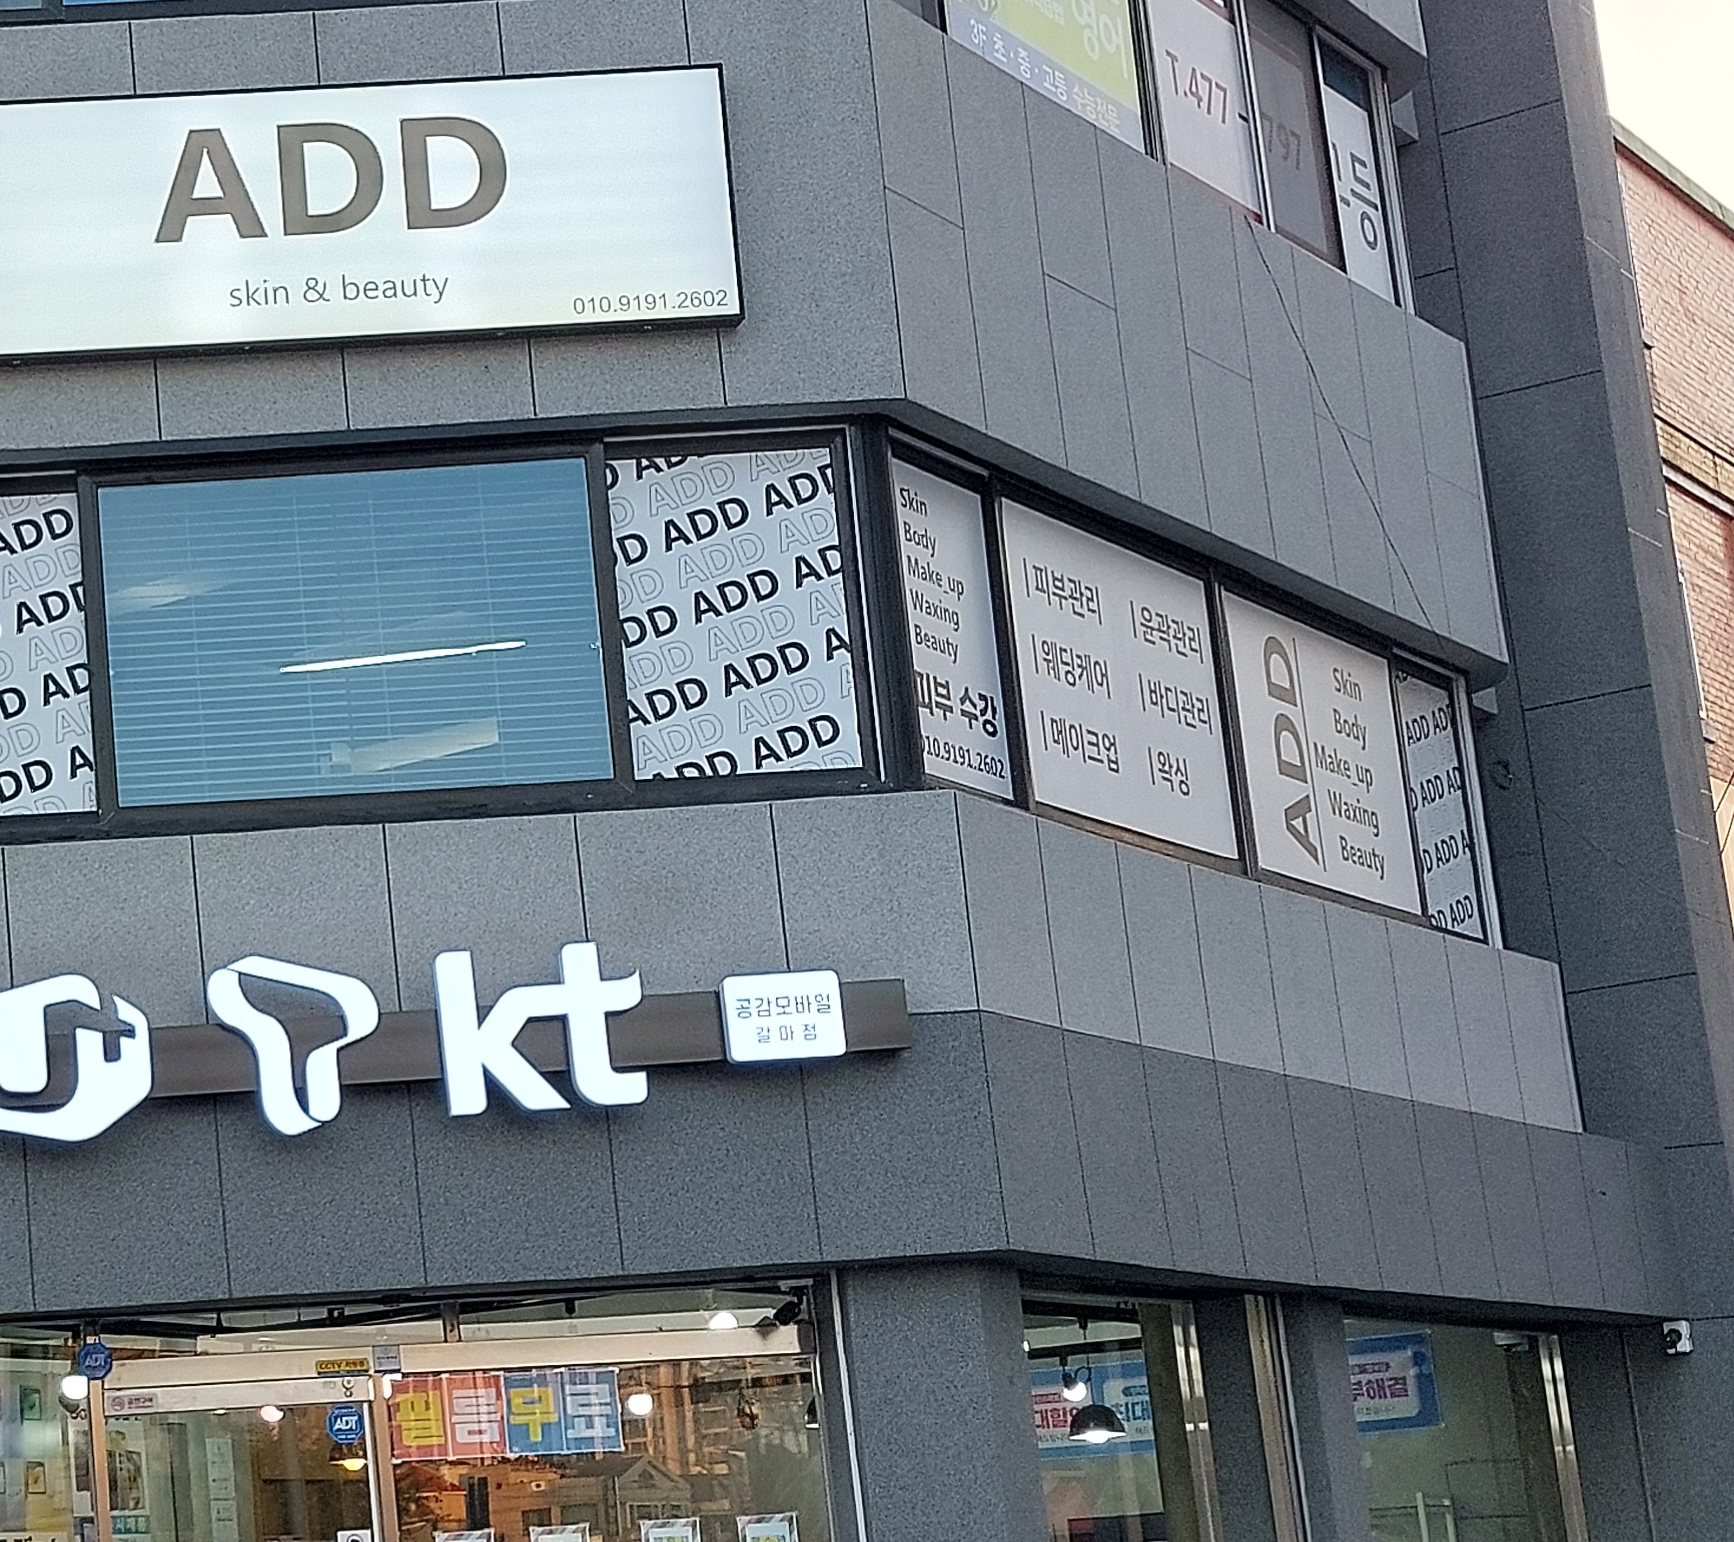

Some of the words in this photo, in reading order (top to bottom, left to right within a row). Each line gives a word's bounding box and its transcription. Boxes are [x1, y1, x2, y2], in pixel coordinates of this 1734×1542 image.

[969, 19, 987, 47] 3F
[154, 116, 510, 244] ADD
[228, 275, 291, 309] skin
[302, 274, 332, 305] &
[342, 270, 450, 307] beauty
[572, 288, 730, 317] 010.9191.2602
[664, 496, 750, 553] ADD
[899, 486, 928, 518] Skin
[903, 520, 936, 559] Body
[694, 569, 780, 626] ADD
[907, 554, 966, 602] Make_up
[909, 588, 960, 633] Waxing
[1032, 563, 1103, 627] 피부관리
[1139, 605, 1205, 665] 윤곽관리
[913, 623, 959, 665] Beauty
[724, 641, 811, 698] ADD
[1041, 638, 1112, 700] 웨딩케어
[1147, 677, 1214, 736] 바디관리
[1332, 667, 1362, 702] Skin
[958, 687, 1000, 739] 수강
[1332, 706, 1368, 752] Body
[1049, 715, 1121, 775] 메이크업
[1156, 749, 1191, 797] 왁싱
[1264, 634, 1319, 866] ADD
[1313, 742, 1375, 795] Make_up
[1326, 787, 1380, 838] Waxing
[1339, 834, 1387, 881] Beauty
[433, 940, 644, 1119] kt
[735, 992, 832, 1019] 공감모바일
[333, 1415, 359, 1431] ADT
